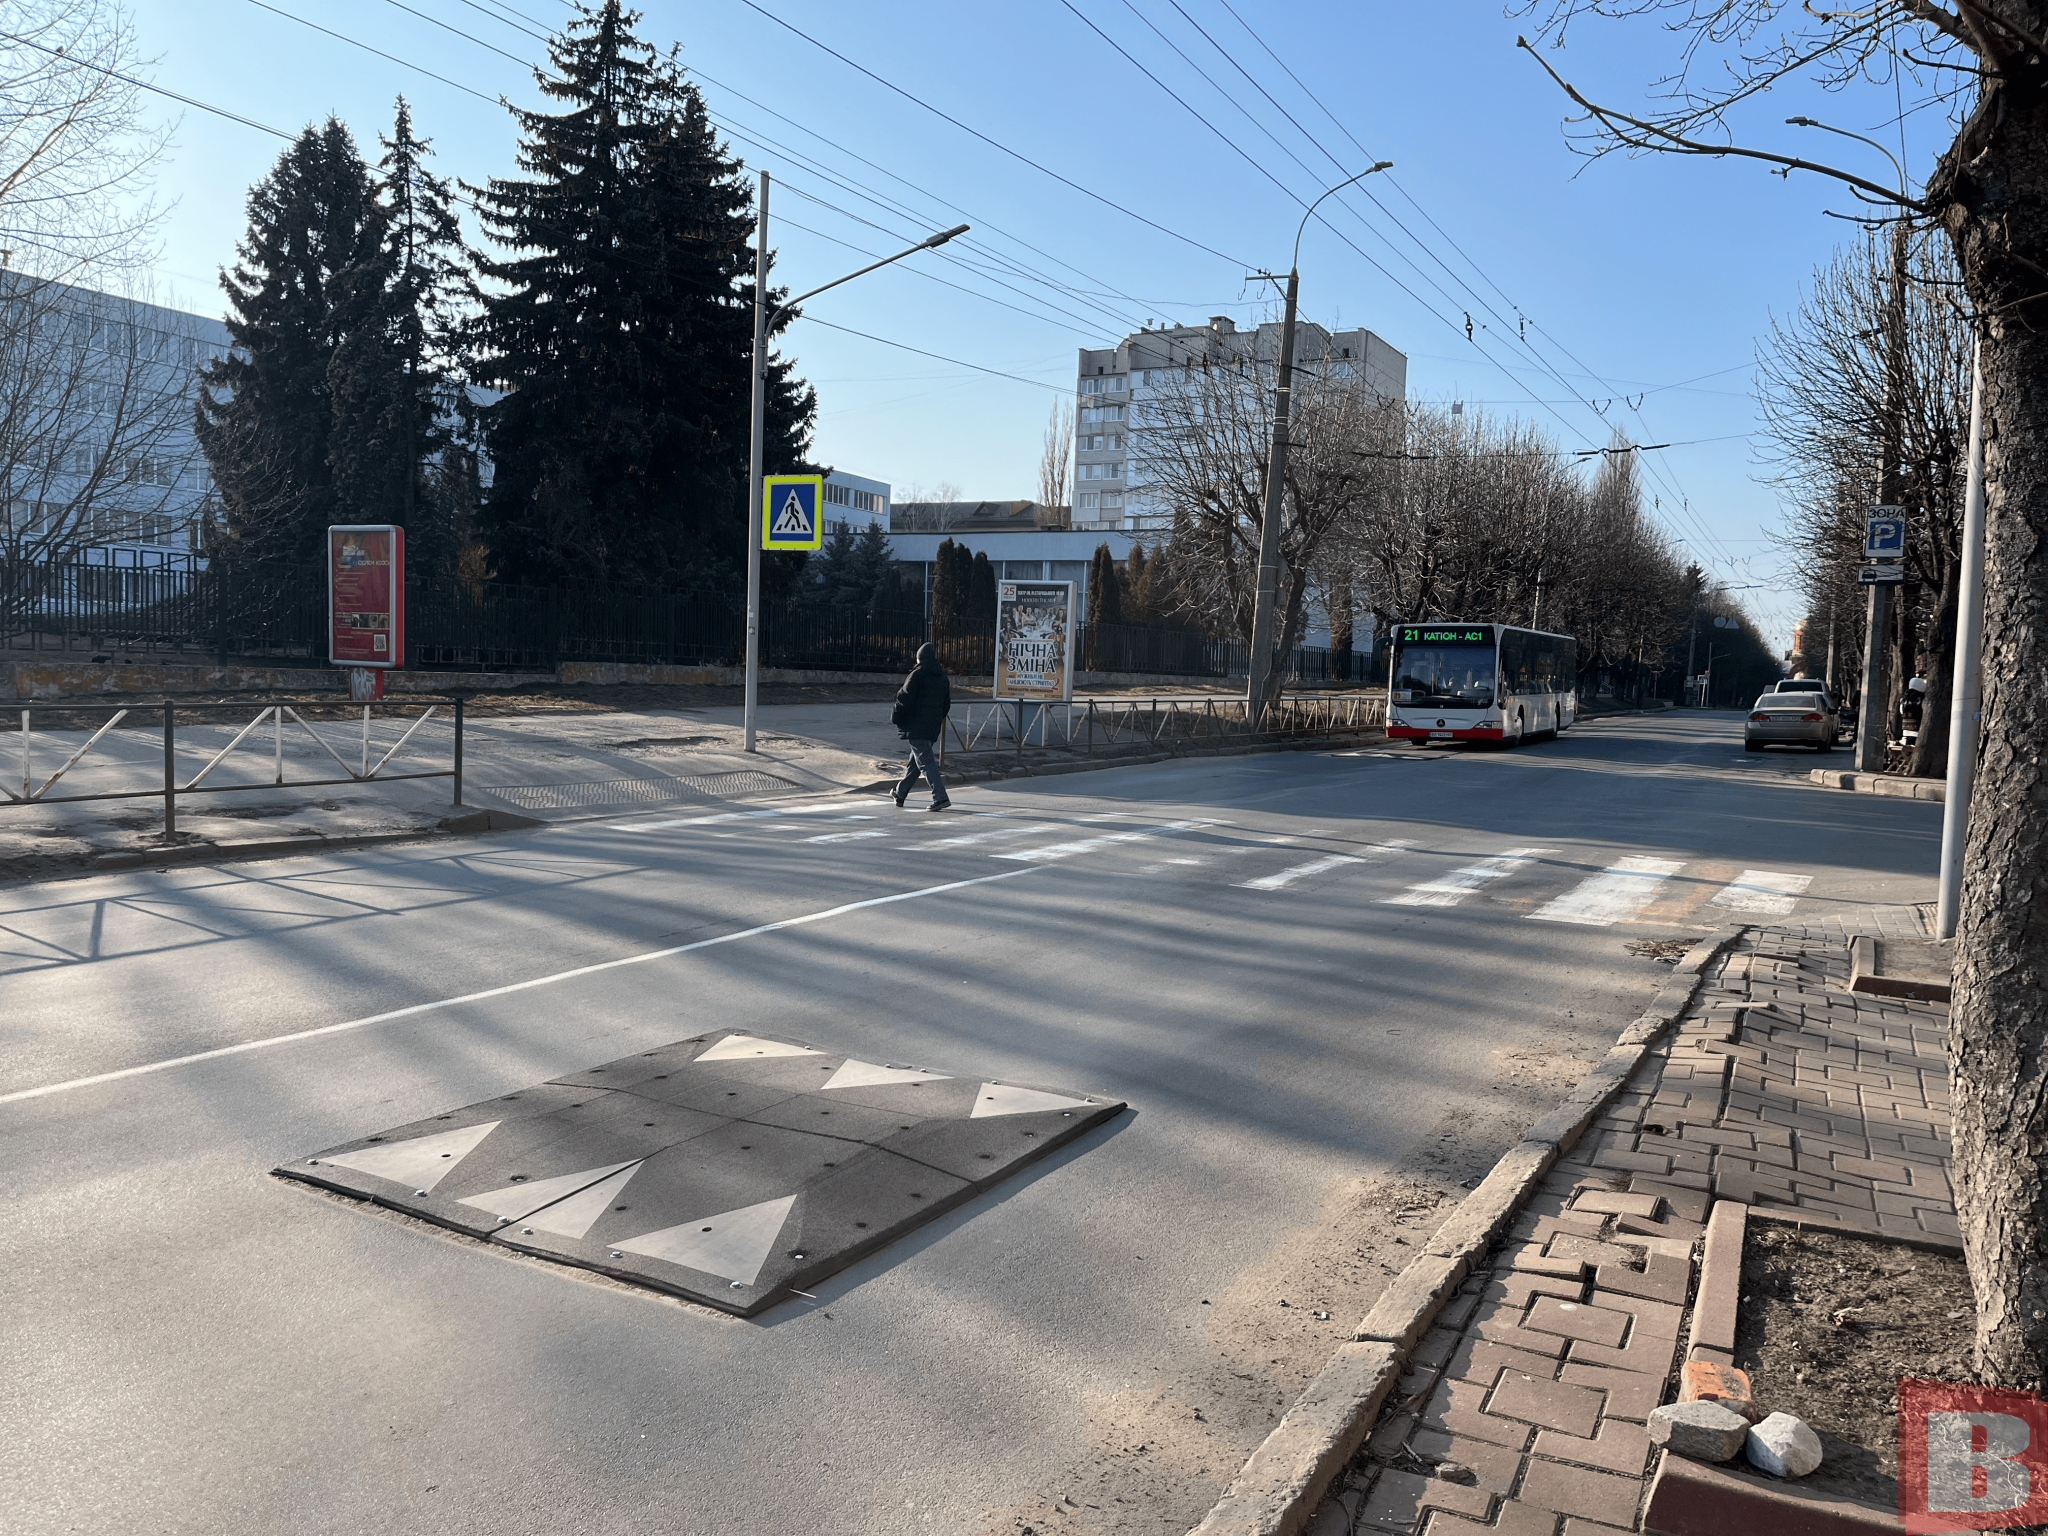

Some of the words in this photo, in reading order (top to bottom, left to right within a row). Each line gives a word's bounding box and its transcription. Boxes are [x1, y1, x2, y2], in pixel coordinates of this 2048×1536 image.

[1868, 508, 1905, 518] ЗОНА
[1003, 587, 1015, 596] 25
[1404, 629, 1418, 641] 21
[1424, 632, 1457, 641] КАТІОН
[1465, 632, 1482, 641] АС1
[1008, 643, 1057, 657] НІЧНА
[1007, 657, 1056, 673] ЗМІНА
[1051, 677, 1061, 691] 2
